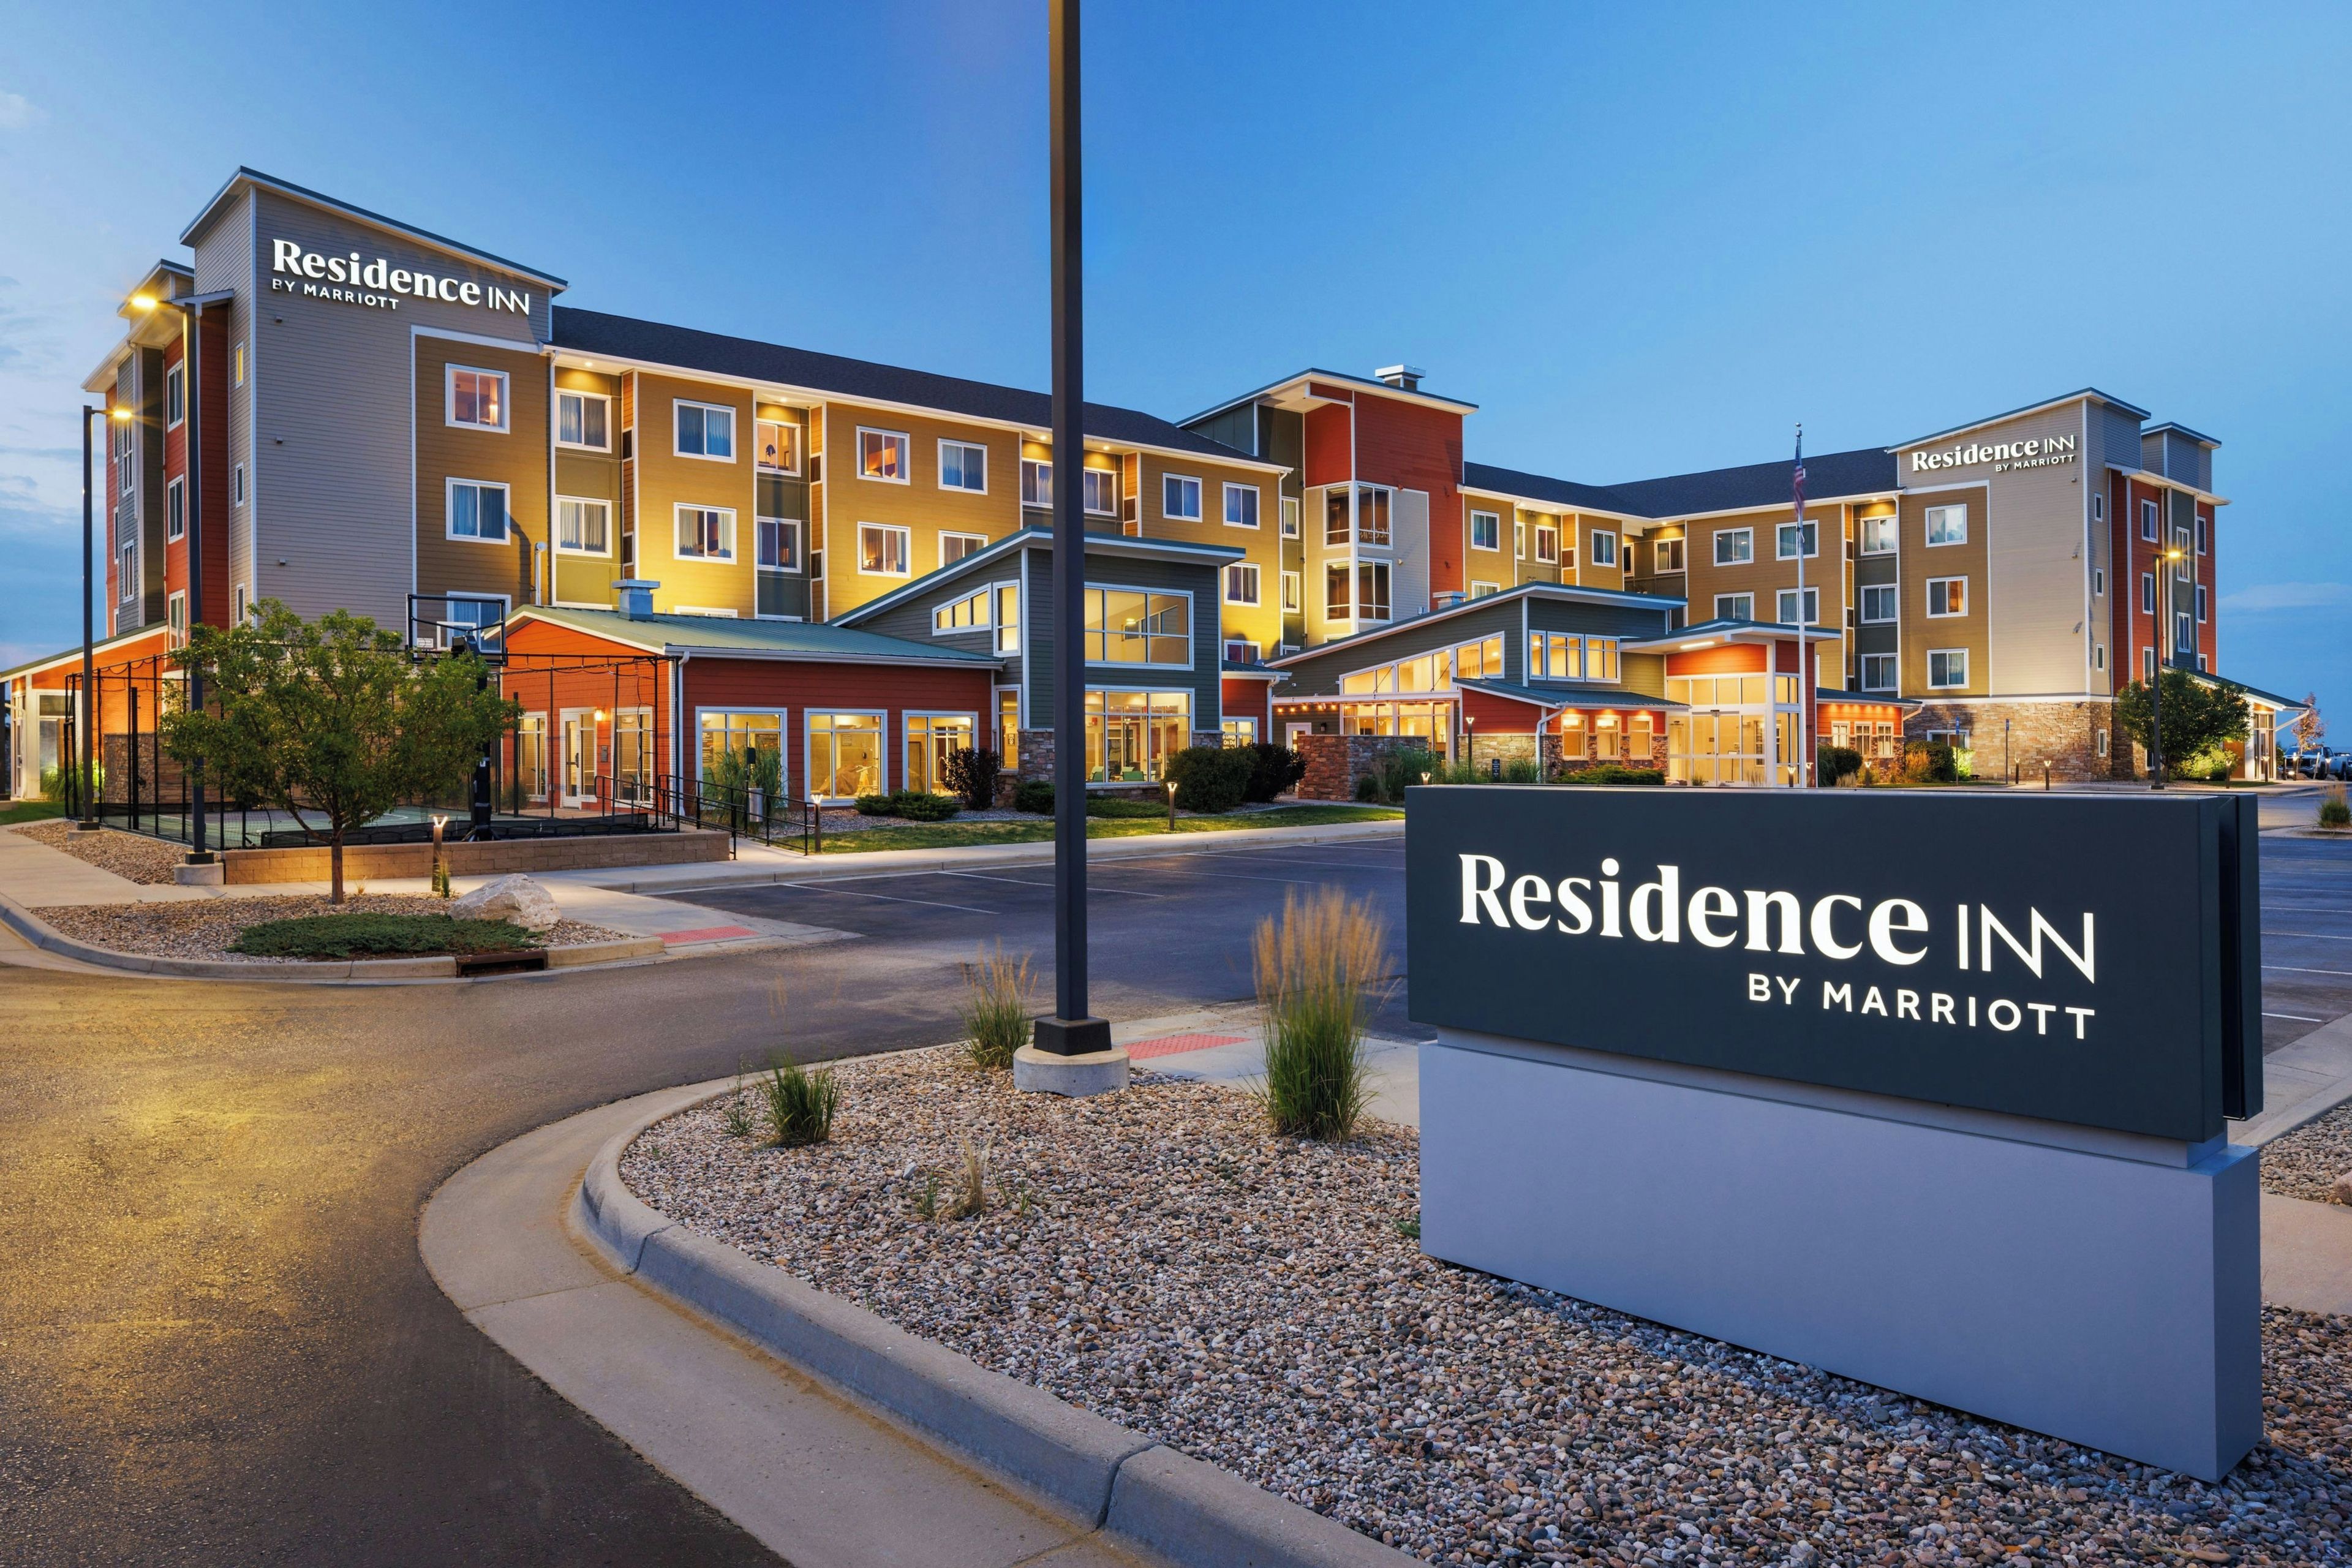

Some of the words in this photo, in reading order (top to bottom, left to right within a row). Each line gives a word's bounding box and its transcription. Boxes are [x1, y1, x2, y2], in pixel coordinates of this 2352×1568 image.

[273, 239, 481, 306] Residence
[488, 286, 529, 315] INN
[273, 278, 295, 292] BY
[304, 284, 399, 309] MARRIOTT
[1912, 440, 2039, 472] Residence
[2044, 434, 2074, 454] INN
[1995, 463, 2009, 472] BY
[2014, 454, 2074, 470] MARRIOTT
[1458, 854, 1929, 965] Residence
[1958, 903, 2095, 984] INN
[1749, 973, 1801, 1005] BY
[1823, 981, 2095, 1039] MARRIOTT
